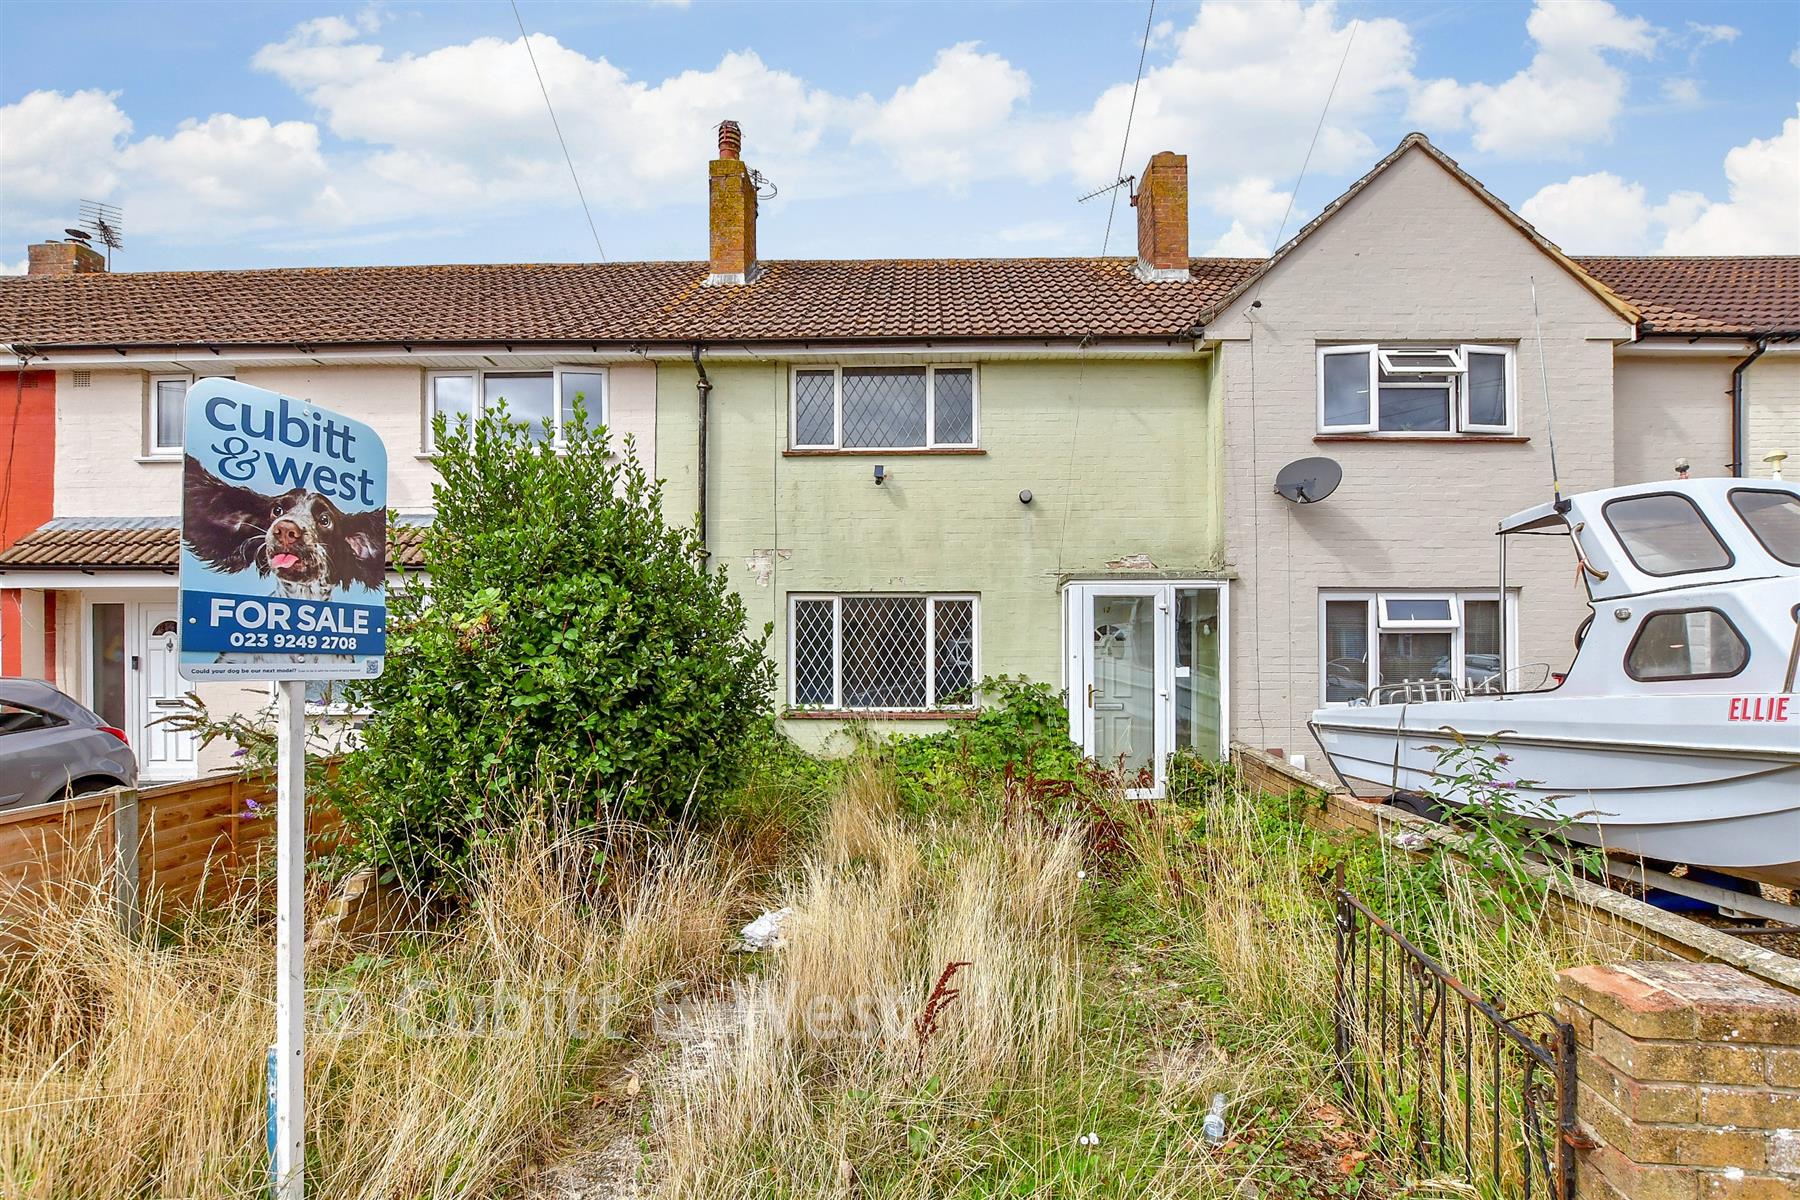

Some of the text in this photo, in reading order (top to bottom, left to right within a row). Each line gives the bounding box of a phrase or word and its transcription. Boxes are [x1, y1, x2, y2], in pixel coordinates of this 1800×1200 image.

[205, 397, 356, 463] cubitt
[211, 437, 374, 506] & west
[210, 598, 369, 634] FOR SALE
[230, 632, 357, 650] 023 9249 2708
[1728, 698, 1790, 722] ELLIE
